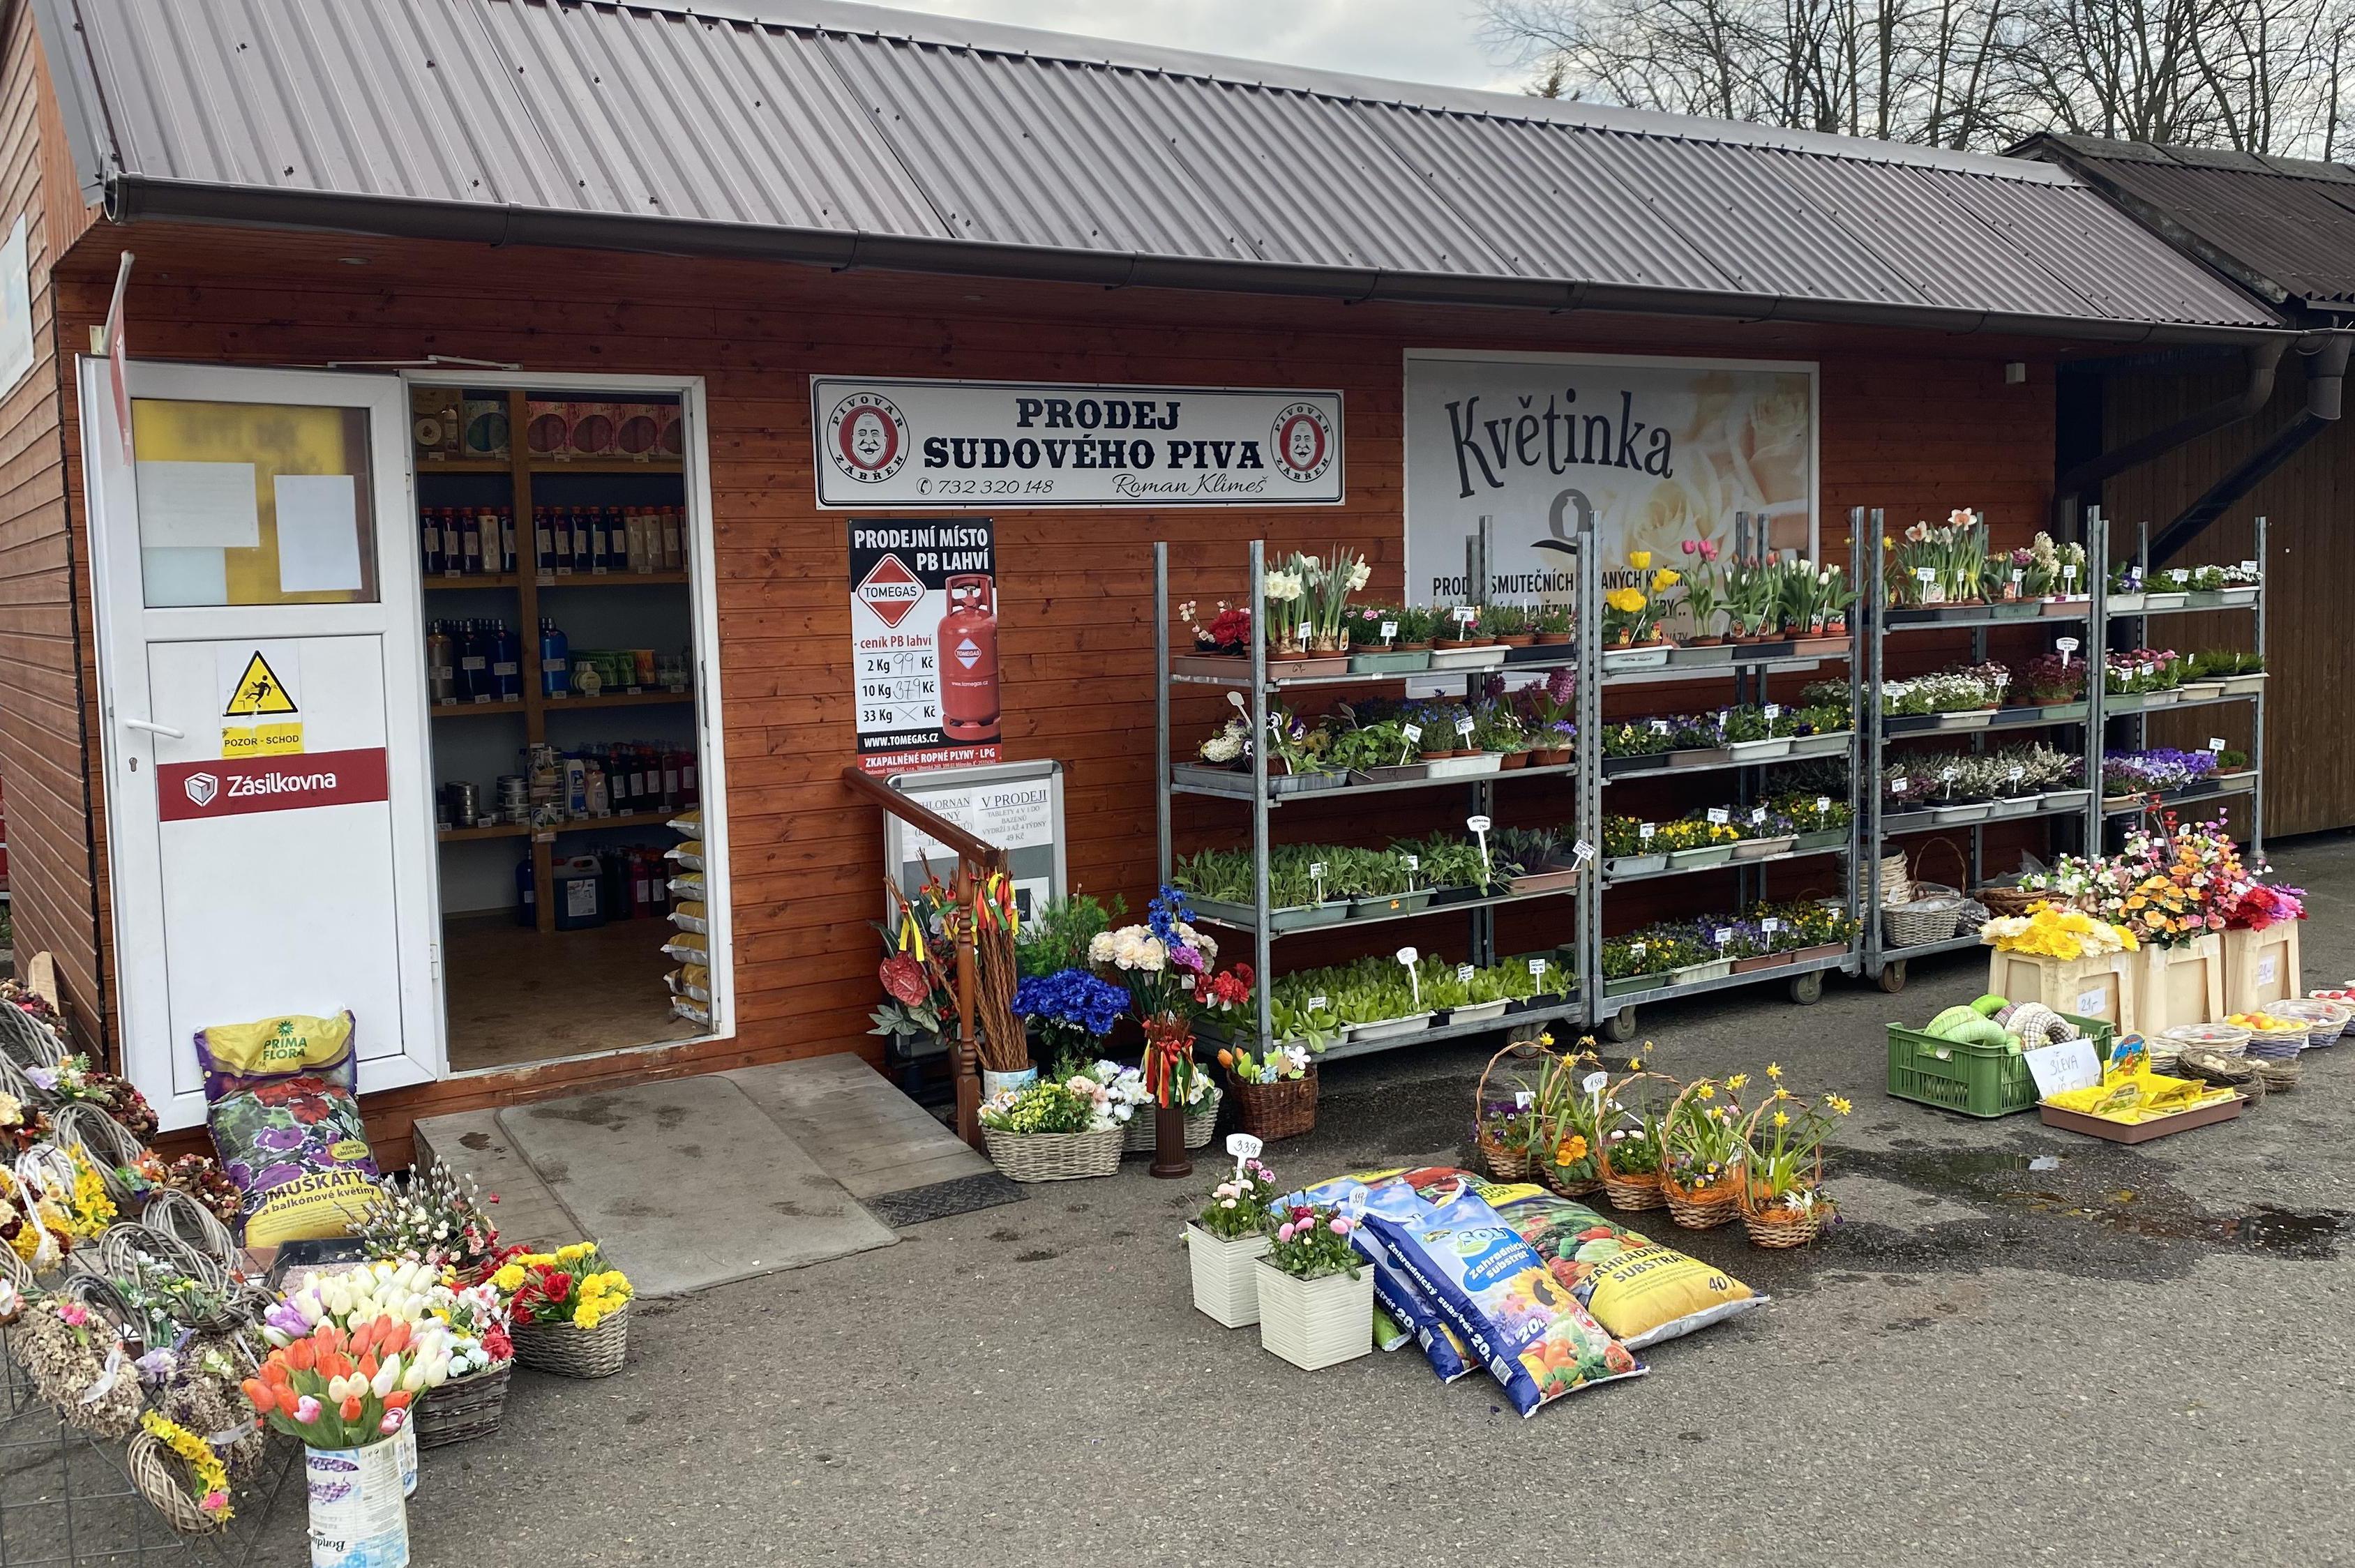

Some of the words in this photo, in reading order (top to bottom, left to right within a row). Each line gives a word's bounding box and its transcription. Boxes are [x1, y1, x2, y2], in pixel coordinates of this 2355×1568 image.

[832, 396, 903, 428] PIVOVAR
[1016, 398, 1180, 430] PRODEJ
[1275, 406, 1329, 434] PIVOVAR
[924, 434, 1155, 469] SUDOVÉHO
[1167, 440, 1264, 469] PIVA
[1445, 388, 1673, 498] Květinka
[836, 454, 903, 481] ZÁBŘEH
[1276, 458, 1329, 481] ZÁBŘEH
[938, 480, 976, 494] 732
[980, 480, 1019, 494] 320
[1026, 480, 1054, 494] 148
[1113, 473, 1191, 497] Roman
[1188, 473, 1268, 496] Klimeš
[855, 525, 935, 549] PRODEJNÍ
[940, 525, 988, 548] MÍSTO
[917, 553, 938, 571] PB
[943, 548, 989, 570] LAHVÍ
[864, 586, 917, 598] TOMEGAS
[860, 634, 887, 649] ceník
[891, 635, 903, 647] PB
[907, 634, 932, 647] lahví
[868, 660, 873, 672] 2
[877, 659, 890, 673] Kg
[894, 653, 914, 674] 99
[921, 656, 933, 668] Kč
[863, 685, 875, 697] 10
[878, 684, 891, 698] Kg
[923, 681, 934, 693] Kč
[864, 710, 875, 722] 33
[879, 709, 892, 723] Kg
[924, 706, 935, 718] Kč
[225, 738, 257, 747] POZOR
[266, 735, 299, 744] SCHOD
[864, 733, 938, 748] WWW.TOMEGAS.CZ
[866, 752, 919, 767] ZKAPALNĚNÉ
[921, 750, 949, 763] ROPNÉ
[950, 750, 975, 761] PLYNY
[980, 748, 995, 758] LPG
[227, 771, 336, 797] Zásilkovna
[919, 797, 970, 809] HLORNAN
[982, 797, 991, 808] V
[995, 790, 1046, 806] PRODEJI
[988, 809, 1014, 817] TABLETY
[1026, 820, 1046, 829] TÝDNY
[263, 1048, 305, 1060] FLORA
[264, 1037, 307, 1049] PRIMA
[2050, 1055, 2079, 1076] SLEVA
[266, 1170, 363, 1203] MUŠKÁTY
[271, 1190, 335, 1212] balkónové
[337, 1187, 375, 1198] květiny
[1387, 1242, 1438, 1296] zahradnický
[1469, 1242, 1530, 1281] zahradnický
[1485, 1250, 1530, 1279] substrát
[1613, 1253, 1689, 1283] SUBSTRÁT
[1709, 1276, 1727, 1291] 40
[1437, 1296, 1474, 1335] substrát
[1470, 1333, 1491, 1363] 20L
[1518, 1317, 1548, 1345] 20L
